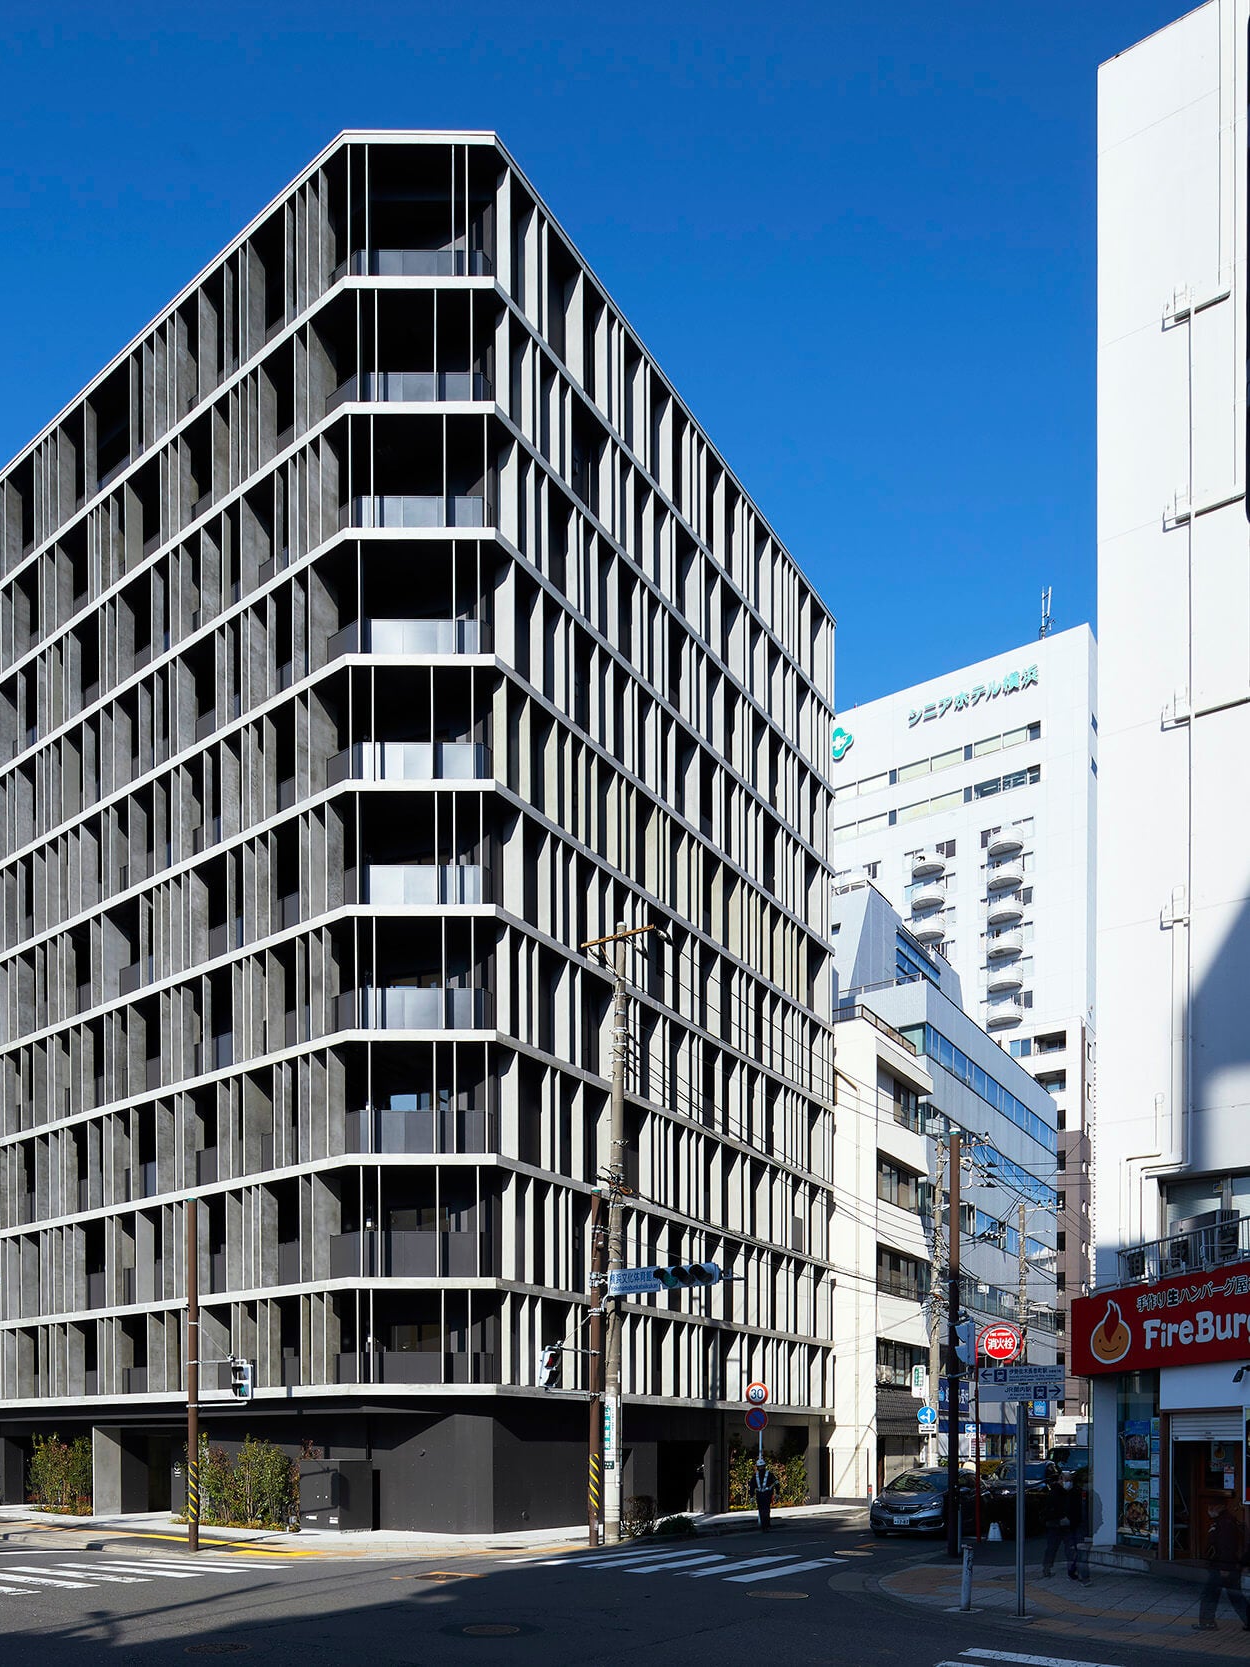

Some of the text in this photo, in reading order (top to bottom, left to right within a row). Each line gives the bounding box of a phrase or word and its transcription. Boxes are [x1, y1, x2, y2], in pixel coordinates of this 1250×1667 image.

[909, 664, 1039, 727] シニアホテル横浜
[988, 1337, 1014, 1350] 消火栓
[751, 1388, 764, 1399] 30
